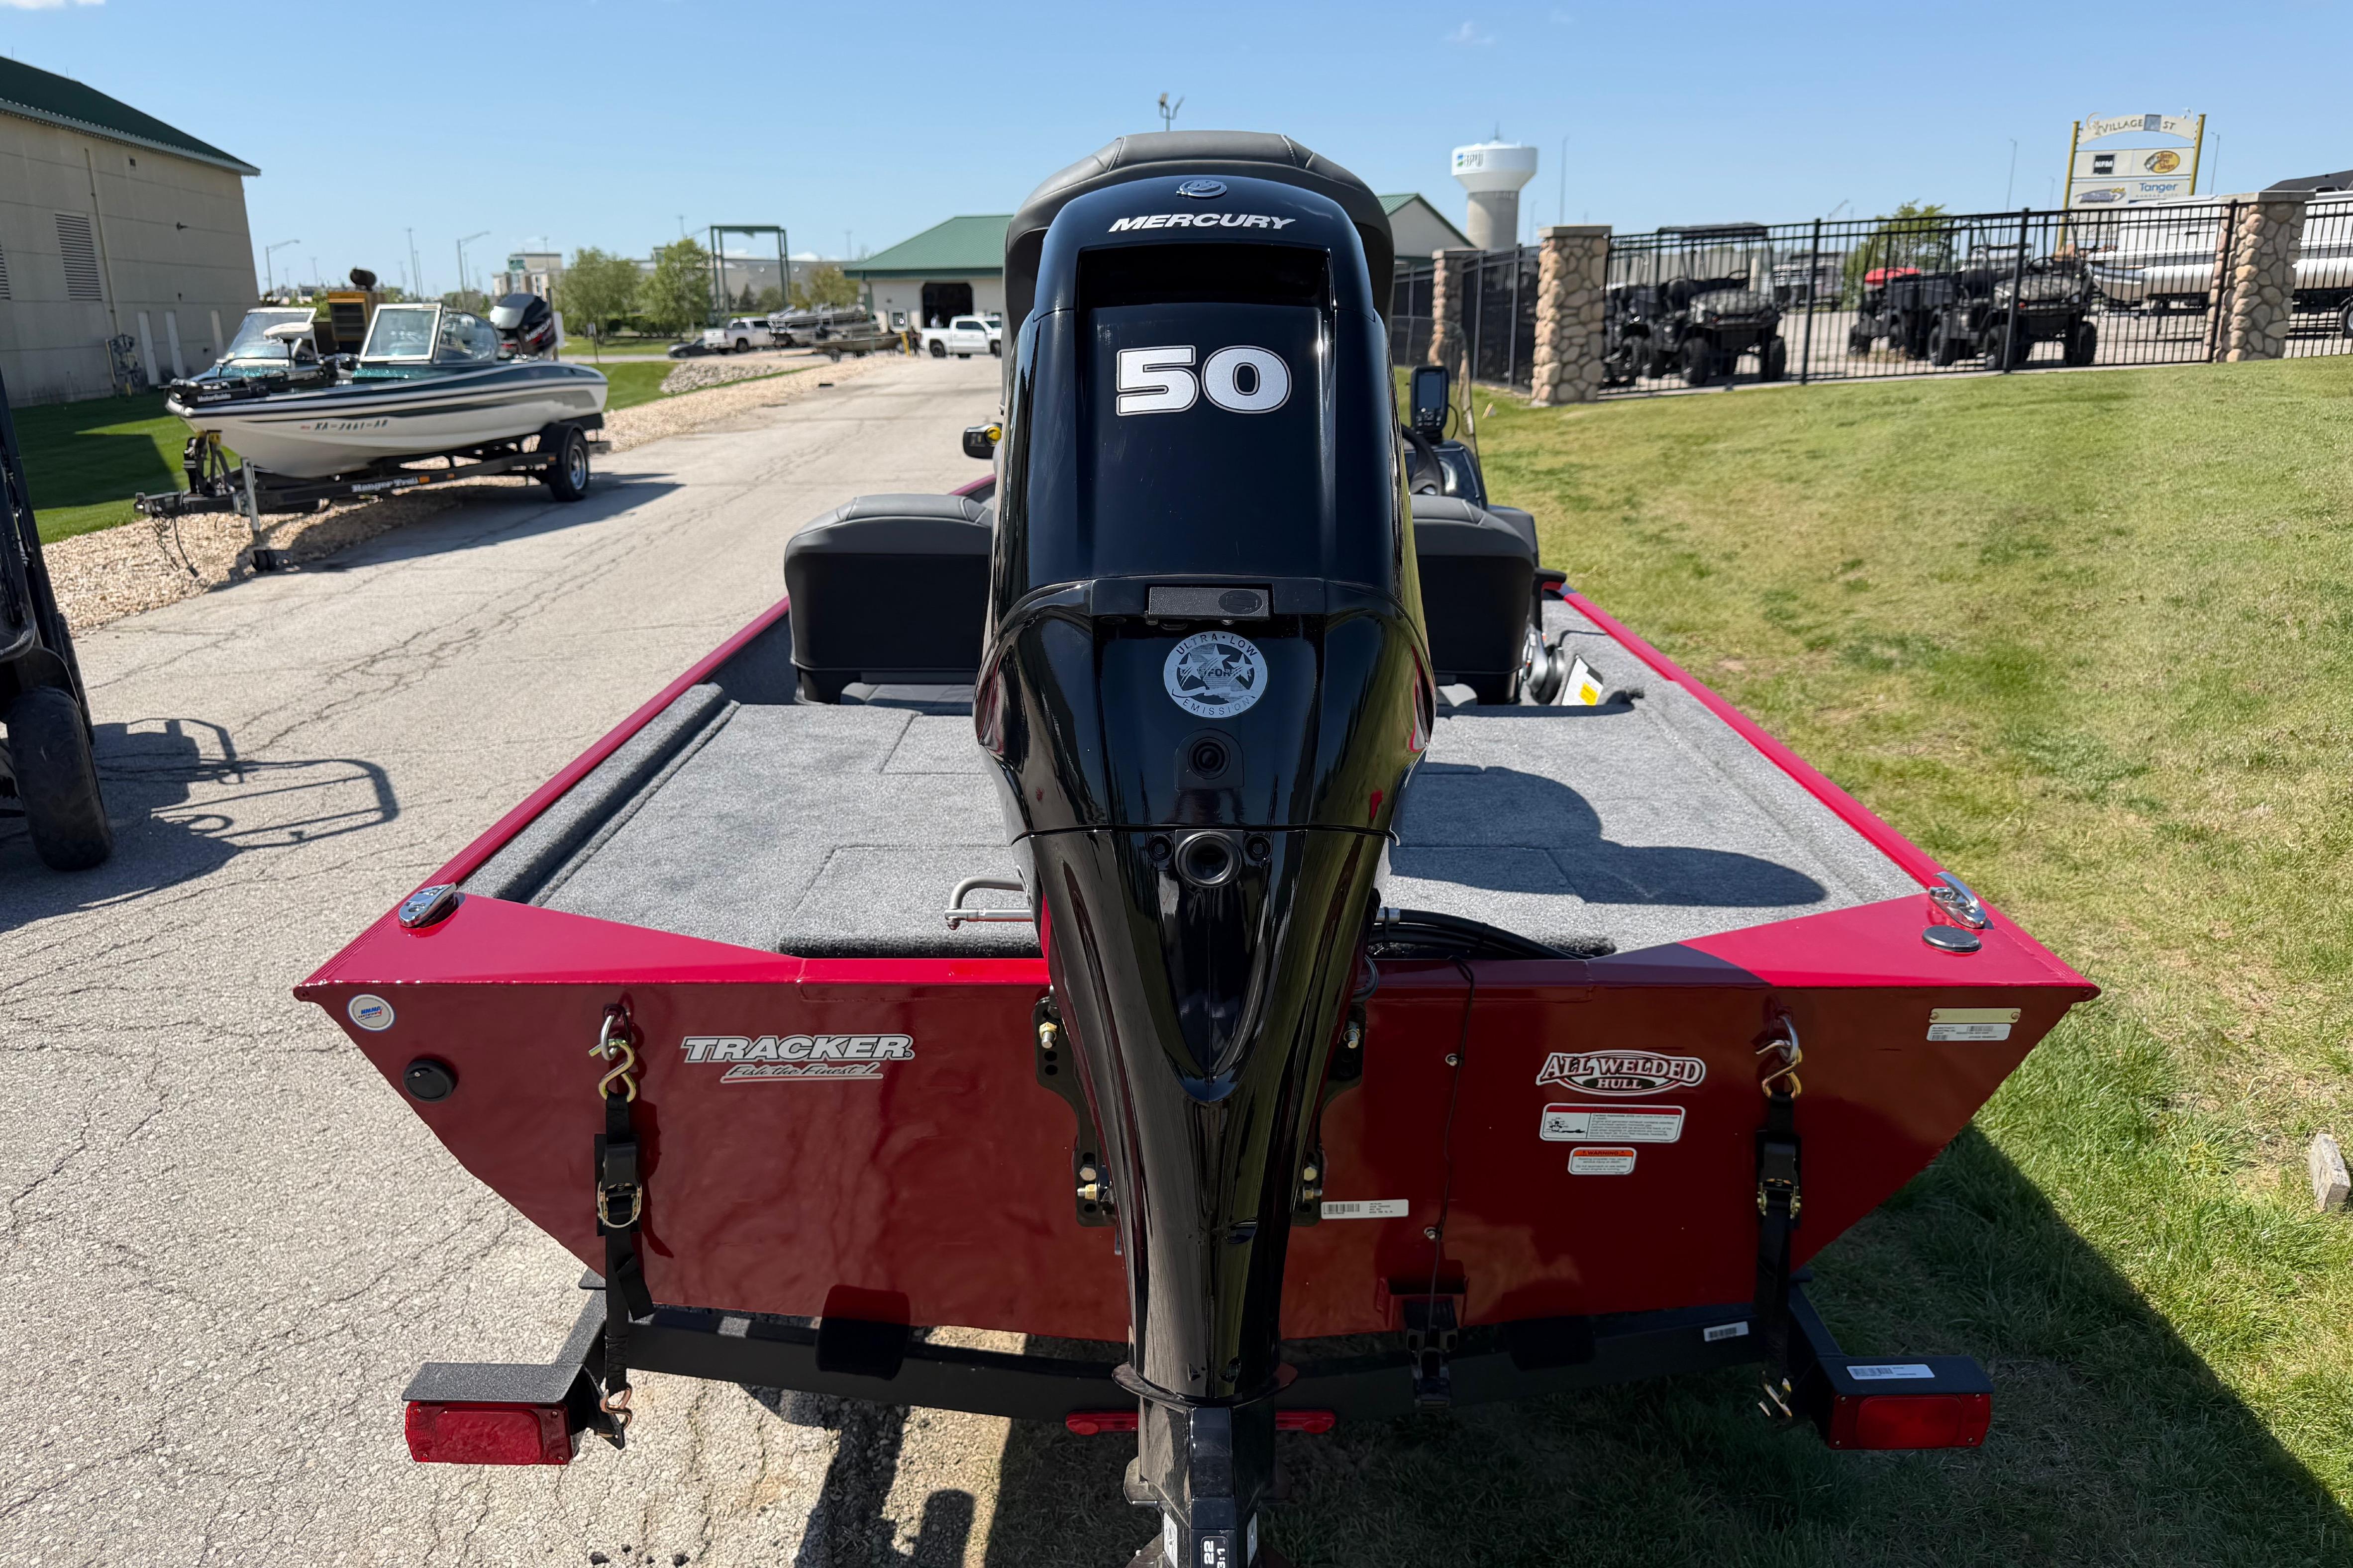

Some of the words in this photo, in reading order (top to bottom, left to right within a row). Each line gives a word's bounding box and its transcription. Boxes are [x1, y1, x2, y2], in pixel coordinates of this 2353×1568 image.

[2100, 119, 2143, 132] VILLAGE
[2140, 183, 2178, 193] Tanger
[1107, 213, 1296, 233] MERCURY
[1117, 345, 1292, 416] 50
[351, 481, 393, 492] Ranger
[1230, 636, 1258, 656] LOW
[1183, 697, 1249, 715] EMISSION
[685, 1037, 911, 1060] TRACKER
[728, 1066, 768, 1076] Fish
[771, 1066, 798, 1076] the
[1541, 1055, 1593, 1080] ALL
[1597, 1058, 1702, 1082] WELDED
[1596, 1078, 1643, 1089] HULL
